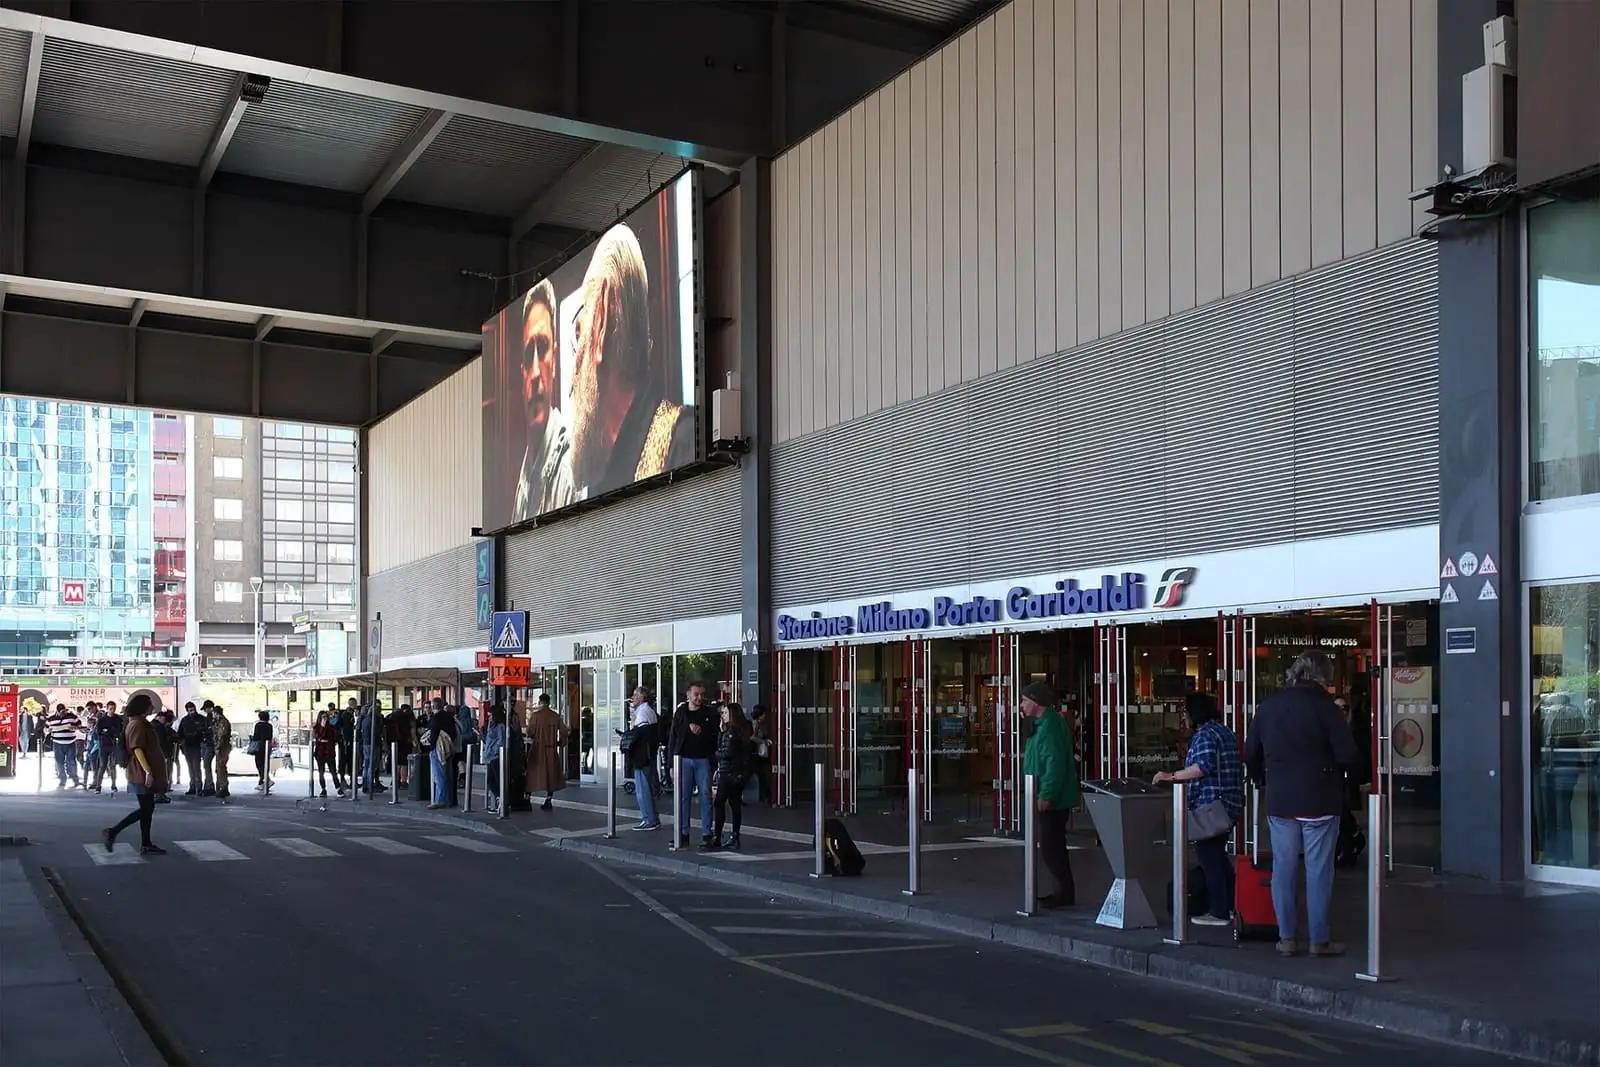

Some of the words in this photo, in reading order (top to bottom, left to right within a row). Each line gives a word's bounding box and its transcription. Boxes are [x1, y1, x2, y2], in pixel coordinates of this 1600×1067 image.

[777, 611, 855, 641] Stazione
[857, 601, 930, 633] Milano
[934, 596, 1001, 626] Porta
[1006, 572, 1145, 619] Garibaldi
[1320, 637, 1358, 648] express
[494, 665, 526, 678] TAXI
[70, 688, 106, 696] DINNER
